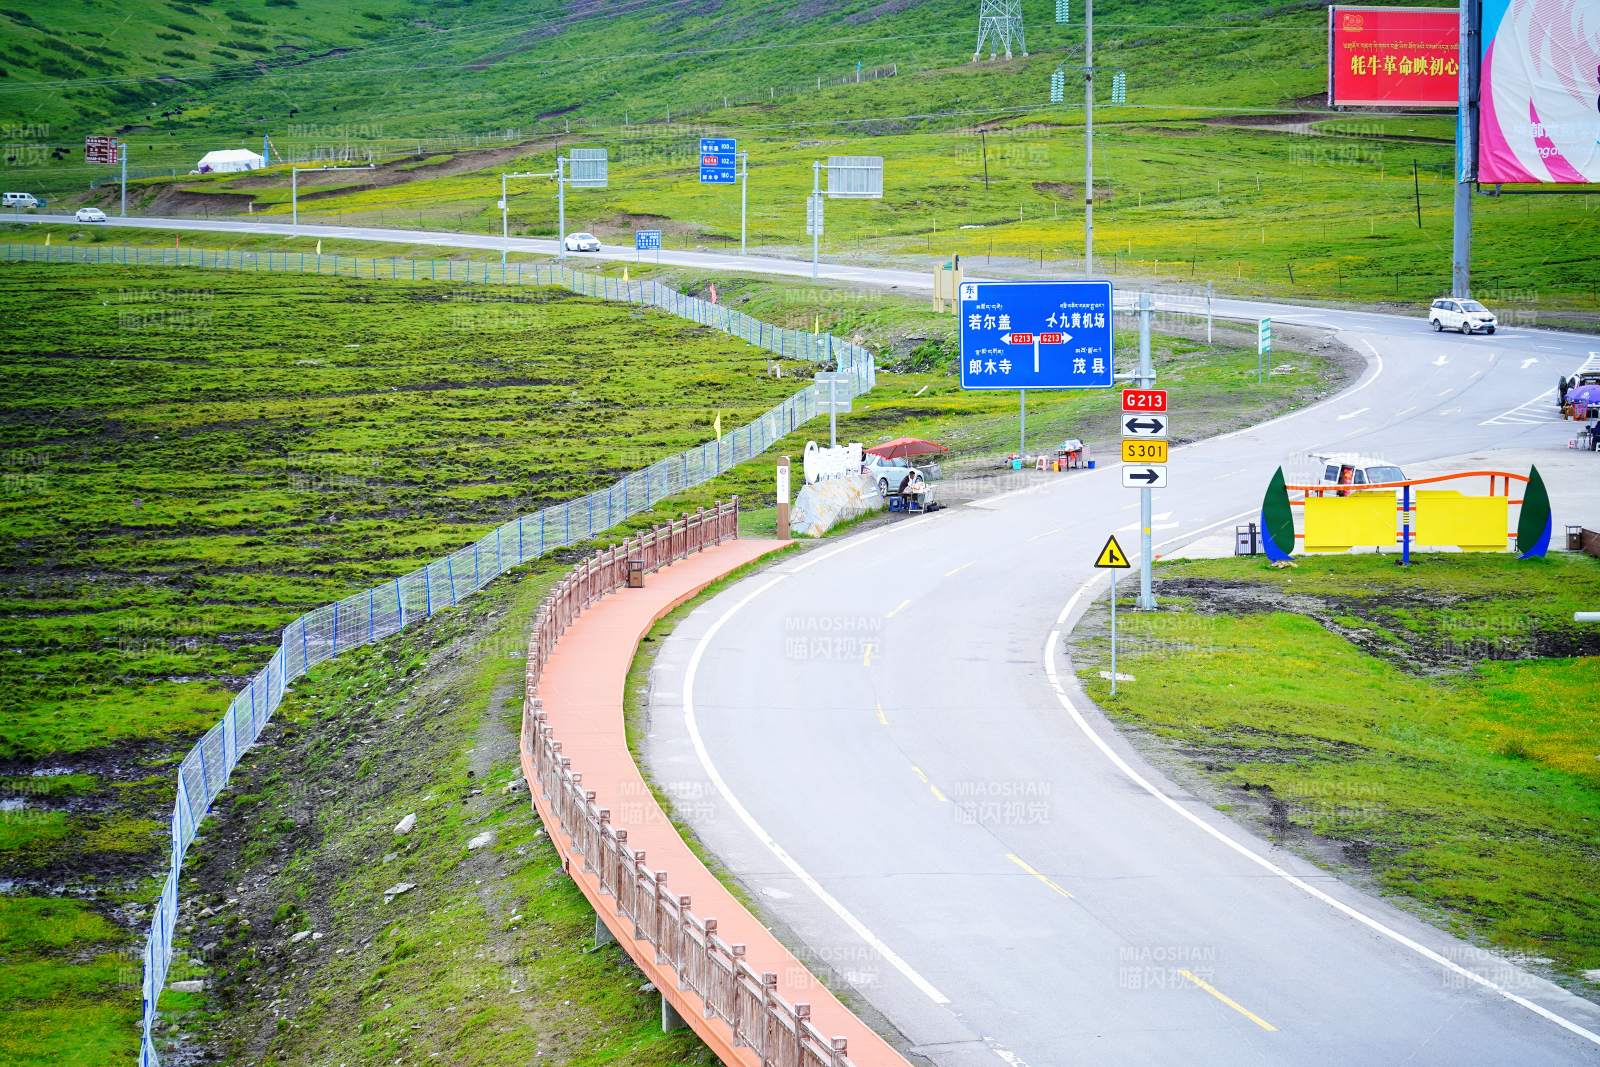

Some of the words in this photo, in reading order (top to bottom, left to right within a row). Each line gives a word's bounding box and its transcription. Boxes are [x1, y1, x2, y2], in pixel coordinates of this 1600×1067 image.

[1351, 55, 1459, 76] 牦牛革命映初心
[966, 285, 975, 294] 东
[968, 313, 1012, 331] 若尔盖
[1059, 312, 1105, 329] 九黄机场
[1013, 334, 1031, 343] G213
[1042, 334, 1060, 343] G213
[969, 358, 1013, 375] 郎木寺
[1072, 357, 1105, 375] 茂县
[1127, 394, 1163, 408] G213
[1128, 445, 1162, 457] S301
